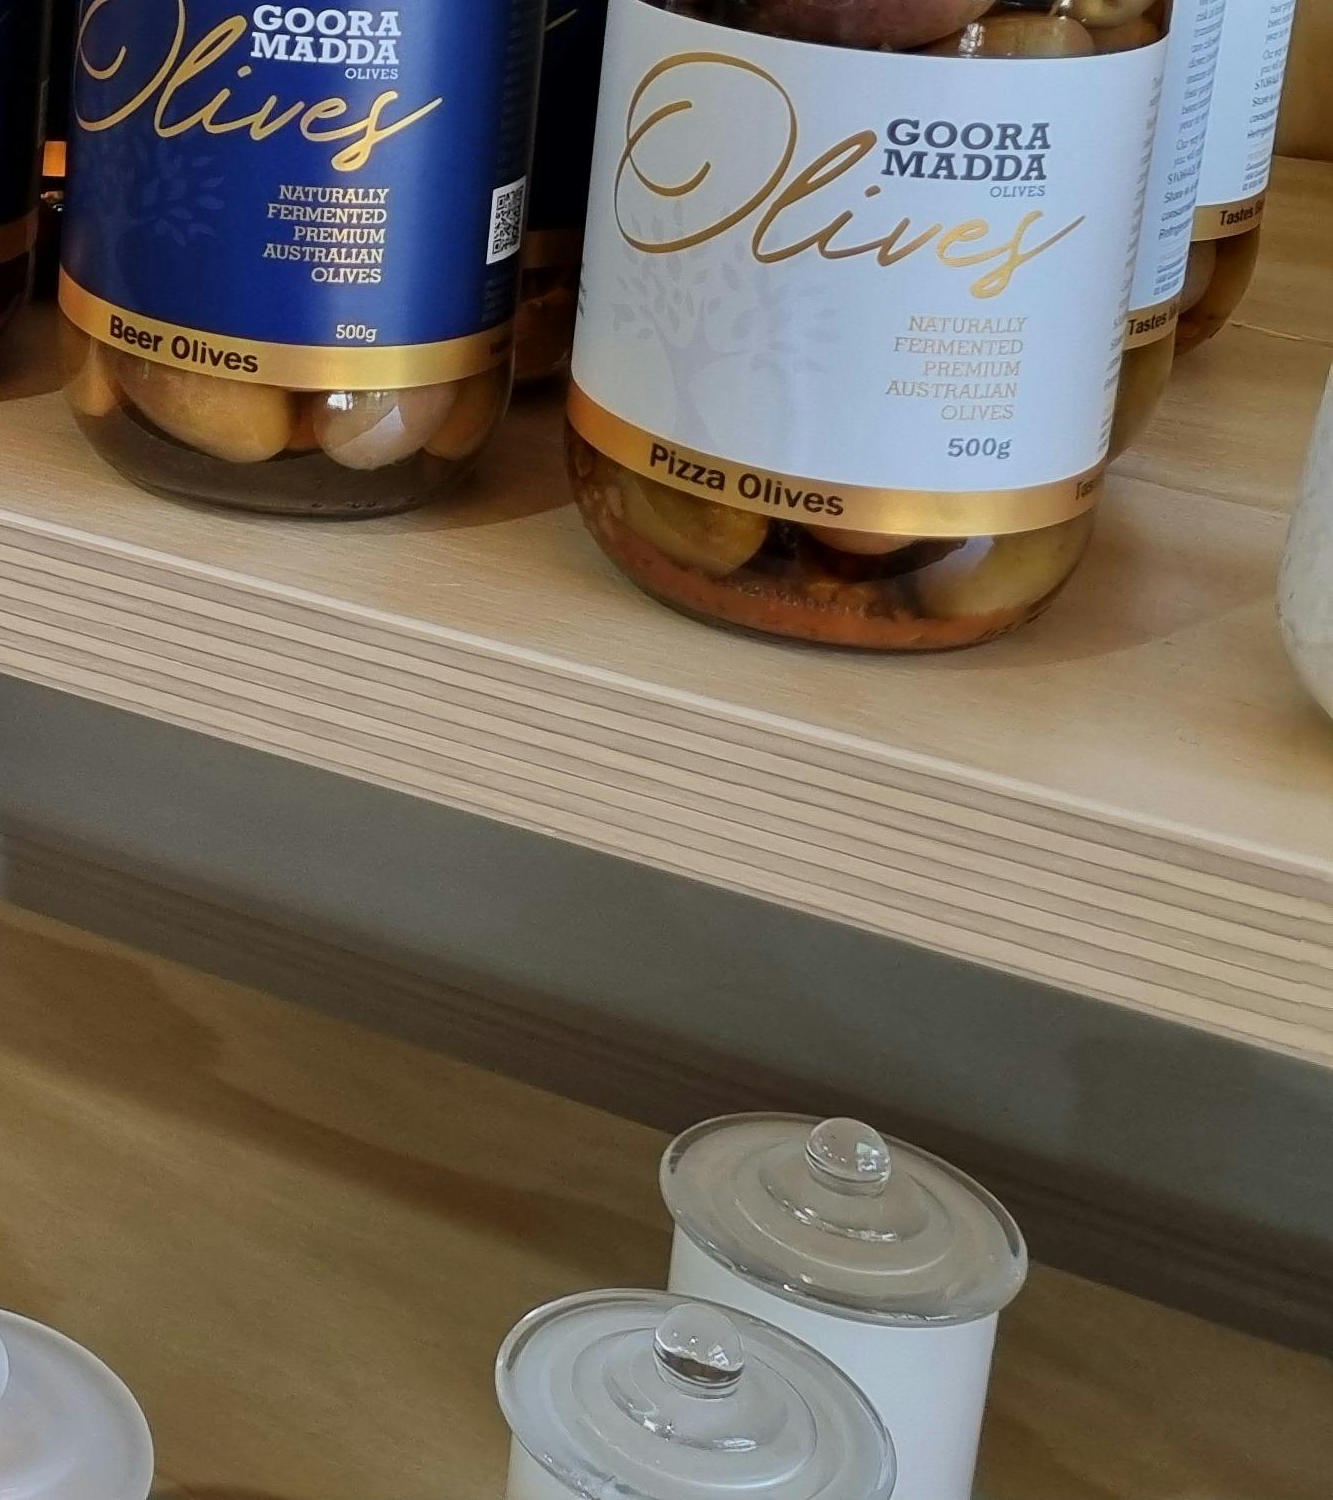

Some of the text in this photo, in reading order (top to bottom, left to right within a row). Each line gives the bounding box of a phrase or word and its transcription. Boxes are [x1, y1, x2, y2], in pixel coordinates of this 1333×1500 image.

[253, 4, 402, 38] GOORA
[250, 31, 400, 66] MADDA
[344, 67, 400, 81] OLIVES
[885, 118, 1051, 151] GOORA
[880, 148, 1048, 181] MADDA
[614, 51, 1087, 300] Olives
[278, 184, 390, 204] NATURALLY
[989, 183, 1047, 198] OLIVES
[267, 204, 388, 225] FERMENTED
[1219, 207, 1254, 227] Tastes
[293, 226, 386, 244] PREMIUM
[262, 243, 384, 265] AUSTRALIAN
[311, 267, 382, 284] OLIVES
[335, 324, 378, 344] 500g
[908, 315, 1028, 335] NATURALLY
[1127, 312, 1168, 337] Tastes
[109, 315, 259, 374] Beer Olives
[893, 337, 1024, 357] FERMENTED
[921, 360, 1021, 378] PREMIUM
[885, 380, 1018, 400] AUSTRALIAN
[940, 403, 1015, 421] OLIVES
[947, 436, 1012, 461] 500g
[649, 442, 845, 518] Pizza Olives
